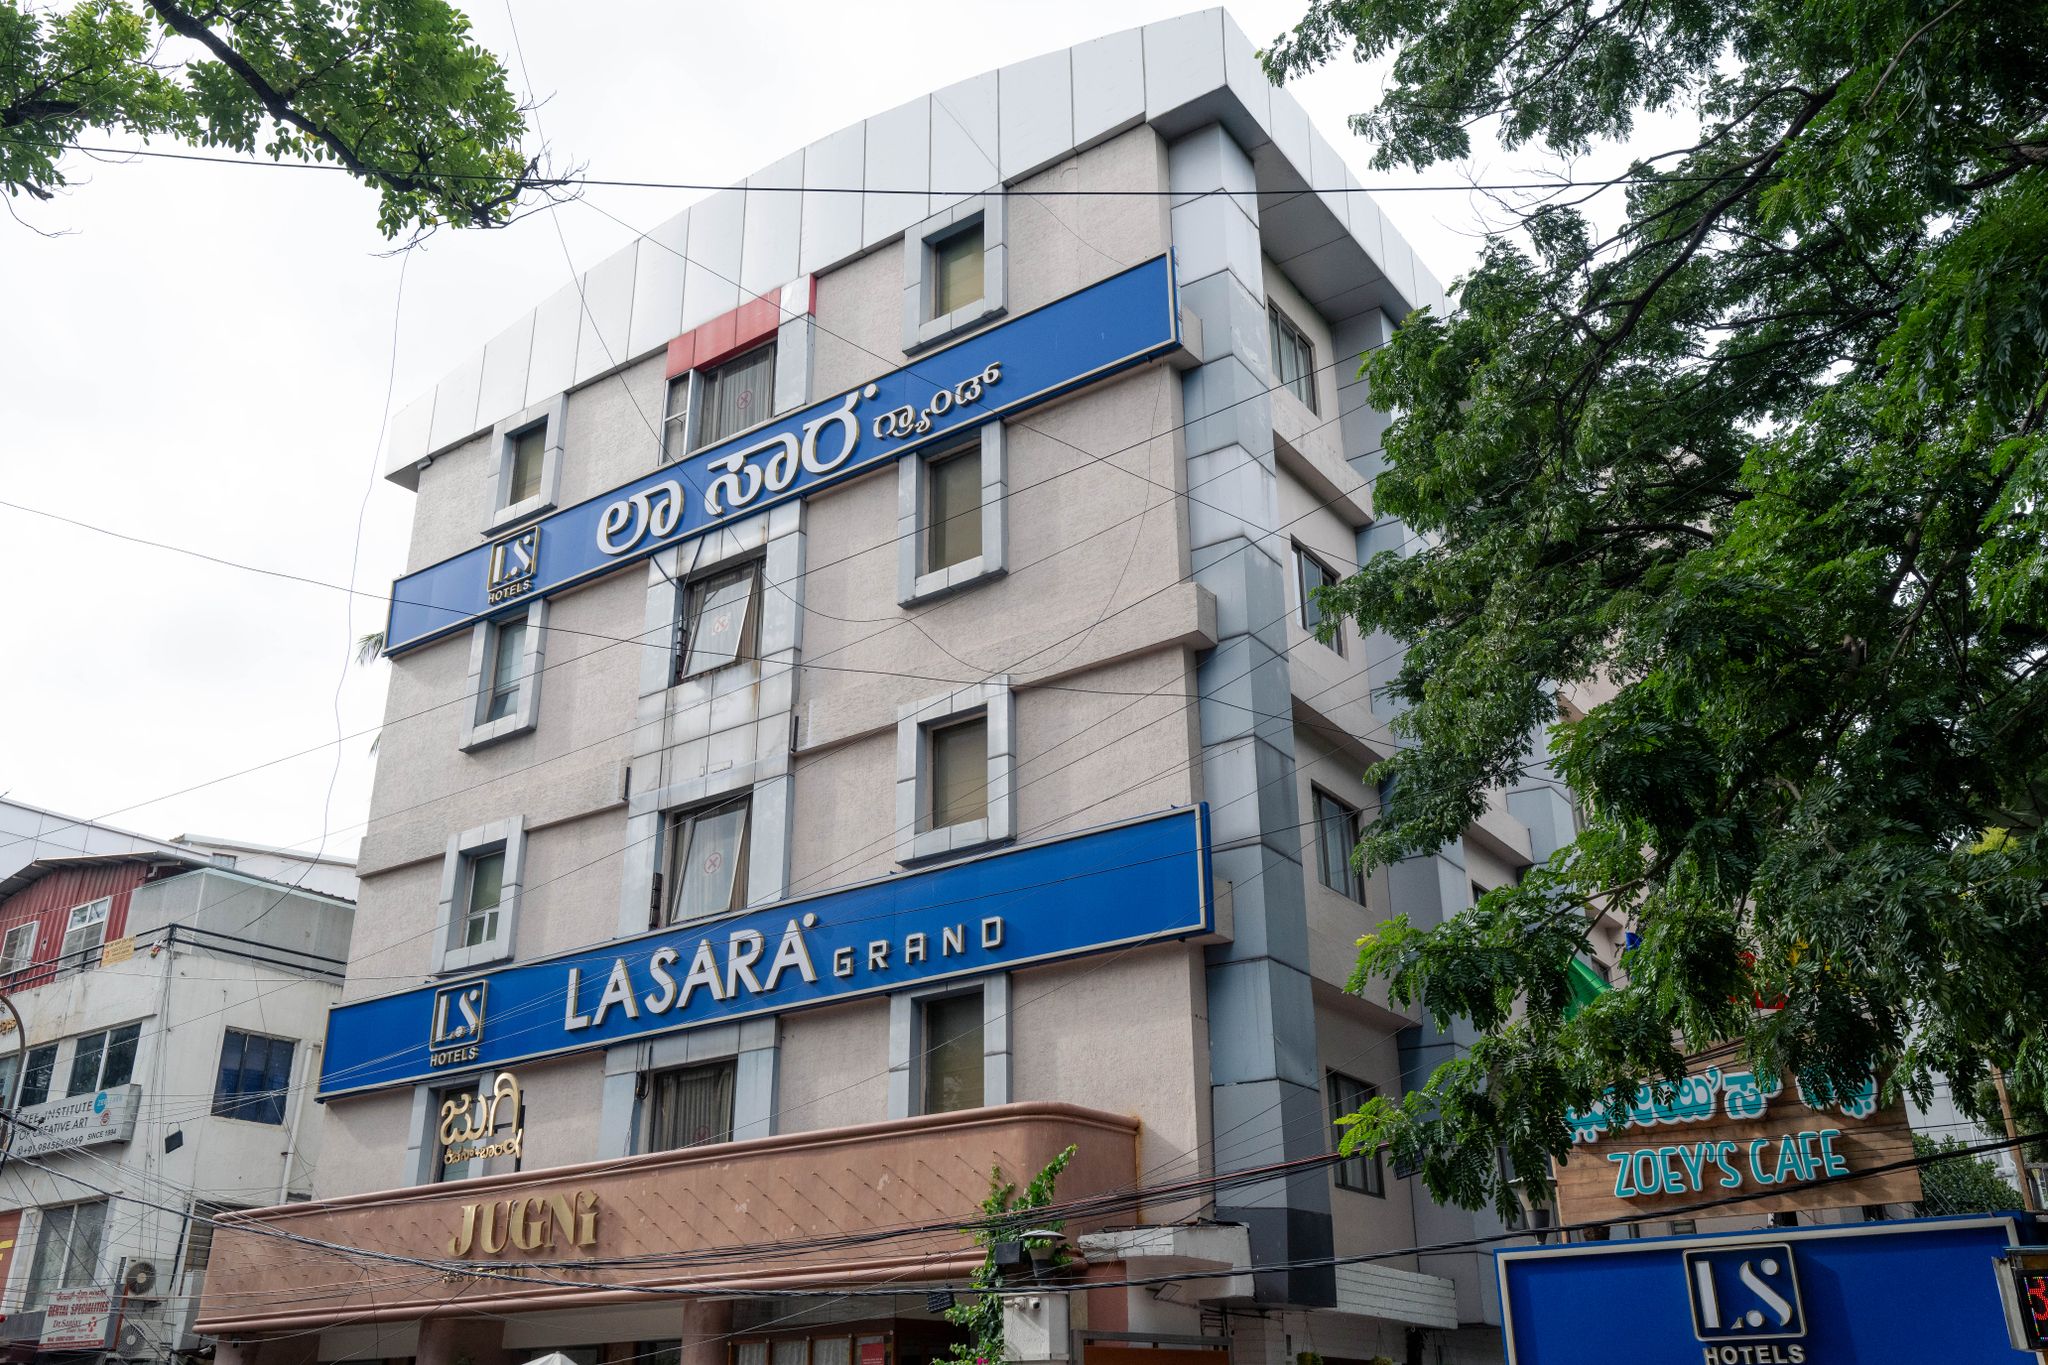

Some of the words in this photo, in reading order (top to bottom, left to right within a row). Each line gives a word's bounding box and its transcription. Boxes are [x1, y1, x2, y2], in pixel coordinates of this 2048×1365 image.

[487, 579, 533, 604] HOTELS
[833, 916, 1003, 978] GRAND
[429, 1047, 479, 1067] HOTELS
[44, 1101, 93, 1120] INSTITUTE
[73, 1117, 88, 1129] ART
[87, 1131, 104, 1140] SINCE
[1608, 1139, 1742, 1199] ZOEY'S
[1748, 1128, 1850, 1184] CAFE
[1702, 1344, 1806, 1365] HOTELS
